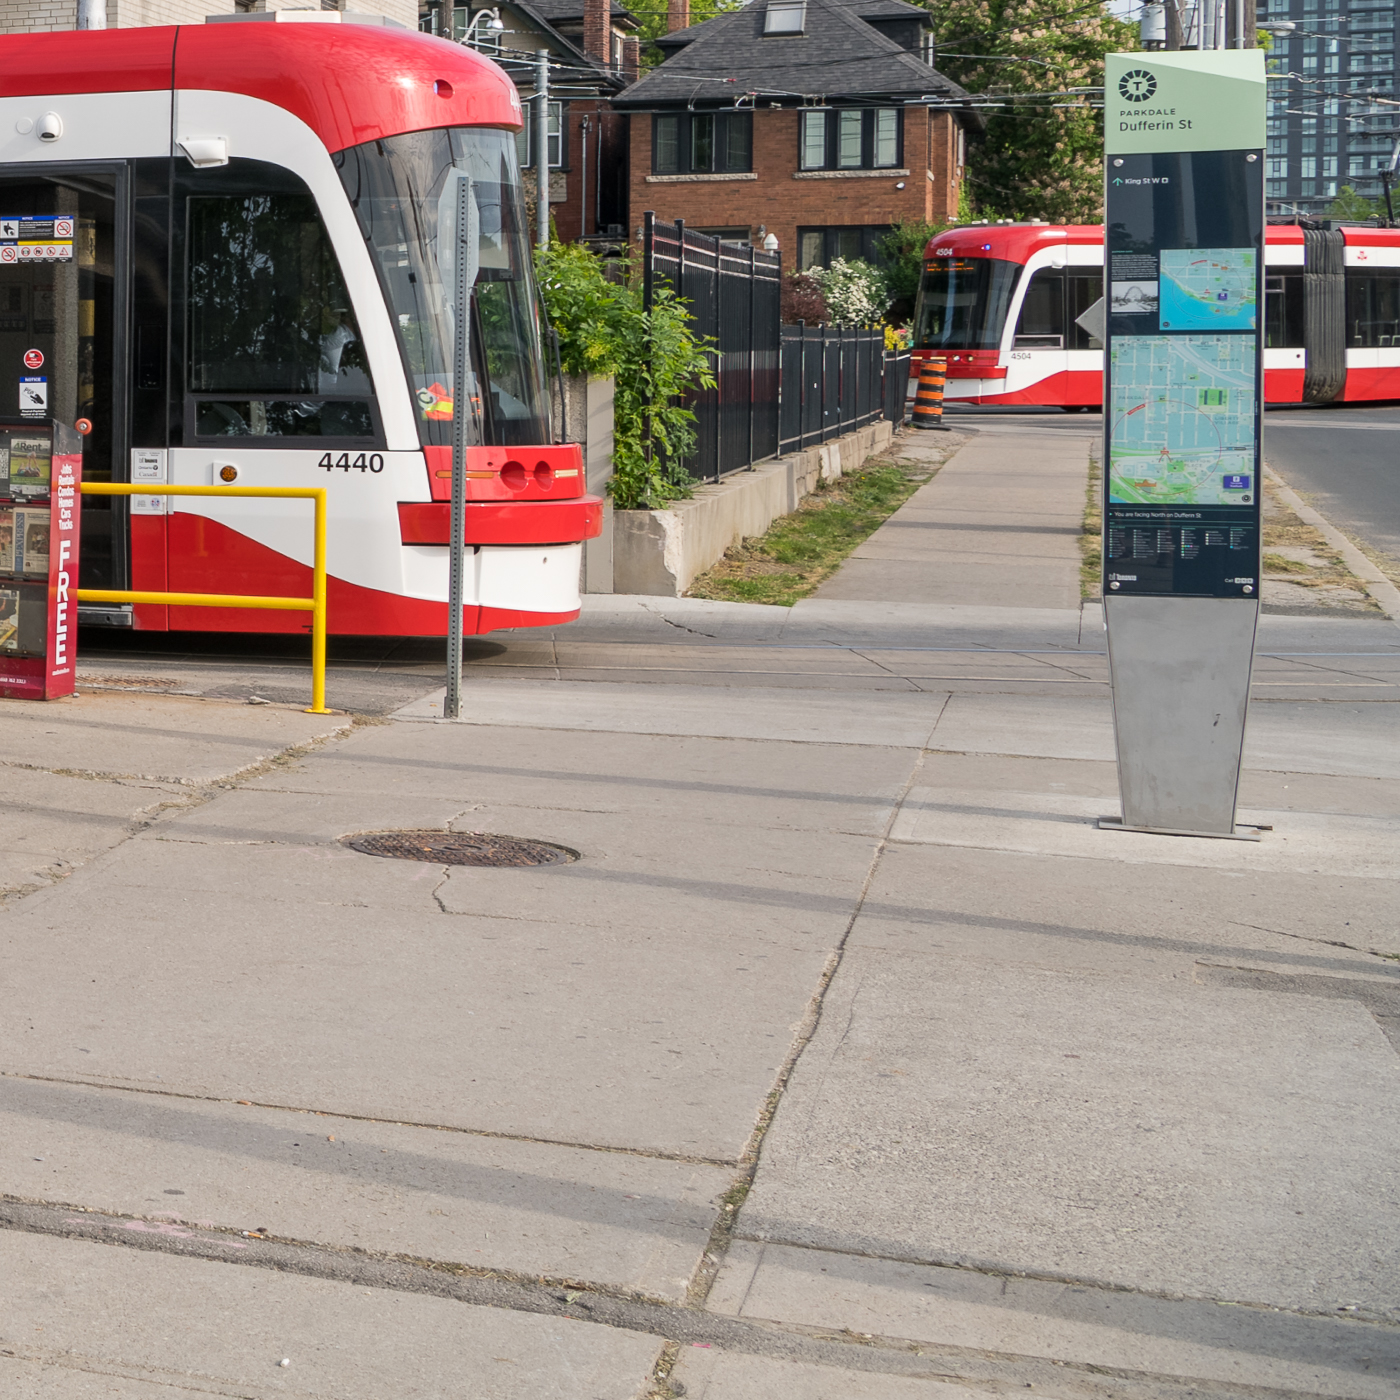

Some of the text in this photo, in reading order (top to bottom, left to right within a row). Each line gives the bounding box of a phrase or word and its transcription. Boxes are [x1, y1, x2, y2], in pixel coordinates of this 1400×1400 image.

[1120, 108, 1176, 117] PARKDALE
[1119, 119, 1193, 132] Dufferin St
[936, 248, 953, 256] 4504
[1011, 352, 1031, 360] 4504
[318, 452, 384, 473] 4440
[61, 464, 72, 474] Jobs
[57, 485, 75, 497] Condos
[58, 497, 74, 508] Homes
[61, 508, 71, 519] Cars
[55, 540, 71, 665] FREE
